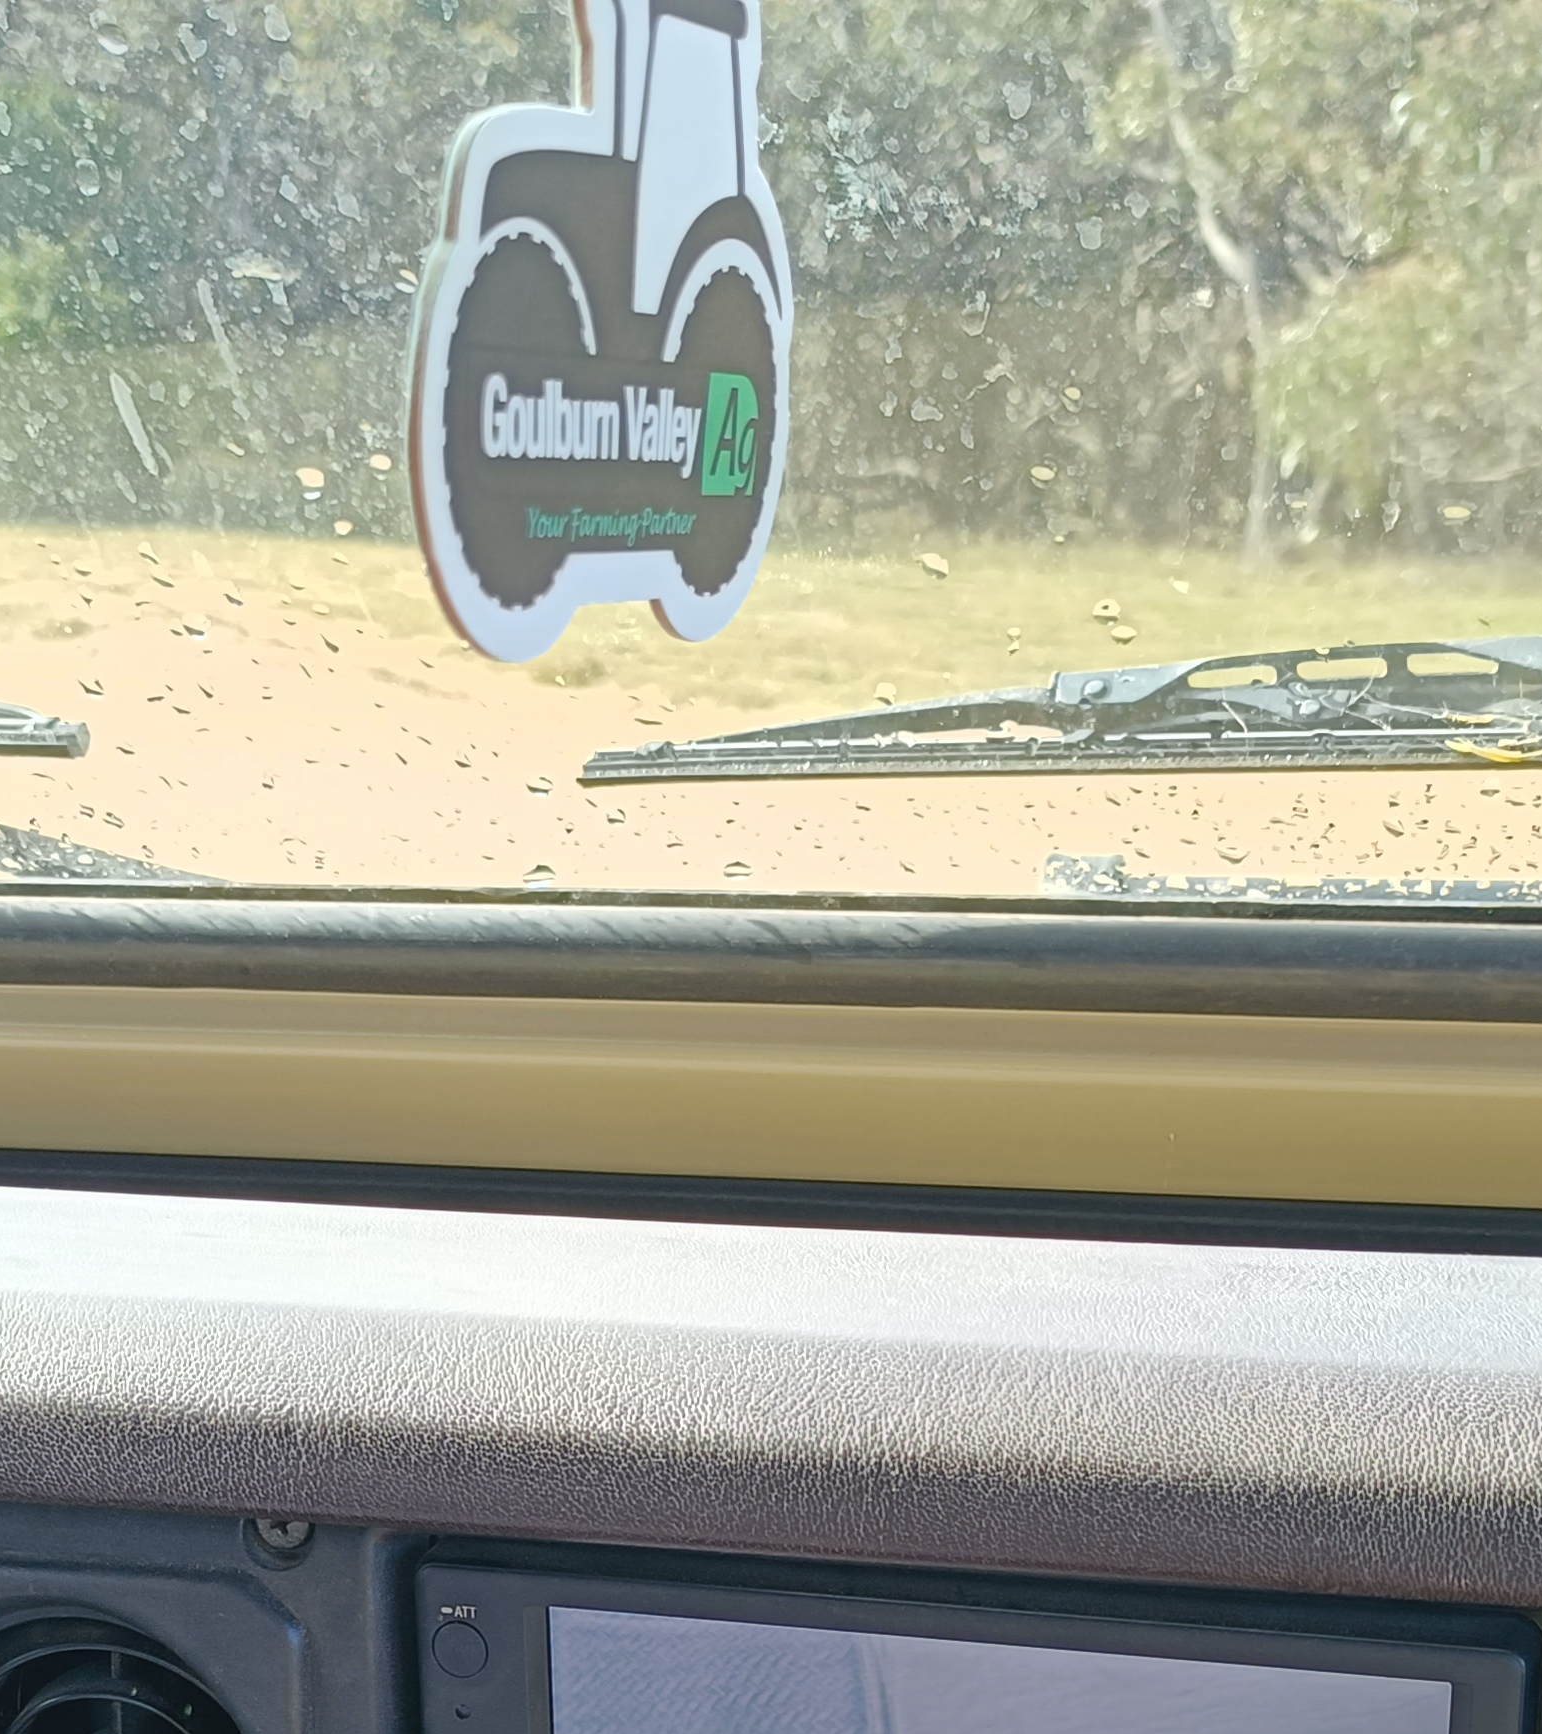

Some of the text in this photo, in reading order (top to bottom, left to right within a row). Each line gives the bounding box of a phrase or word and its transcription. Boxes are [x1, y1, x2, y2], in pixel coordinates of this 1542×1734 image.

[481, 372, 620, 460] Goulburn
[623, 384, 702, 479] Valley
[527, 506, 698, 548] Your Farming Partner
[454, 1605, 477, 1619] ATT
